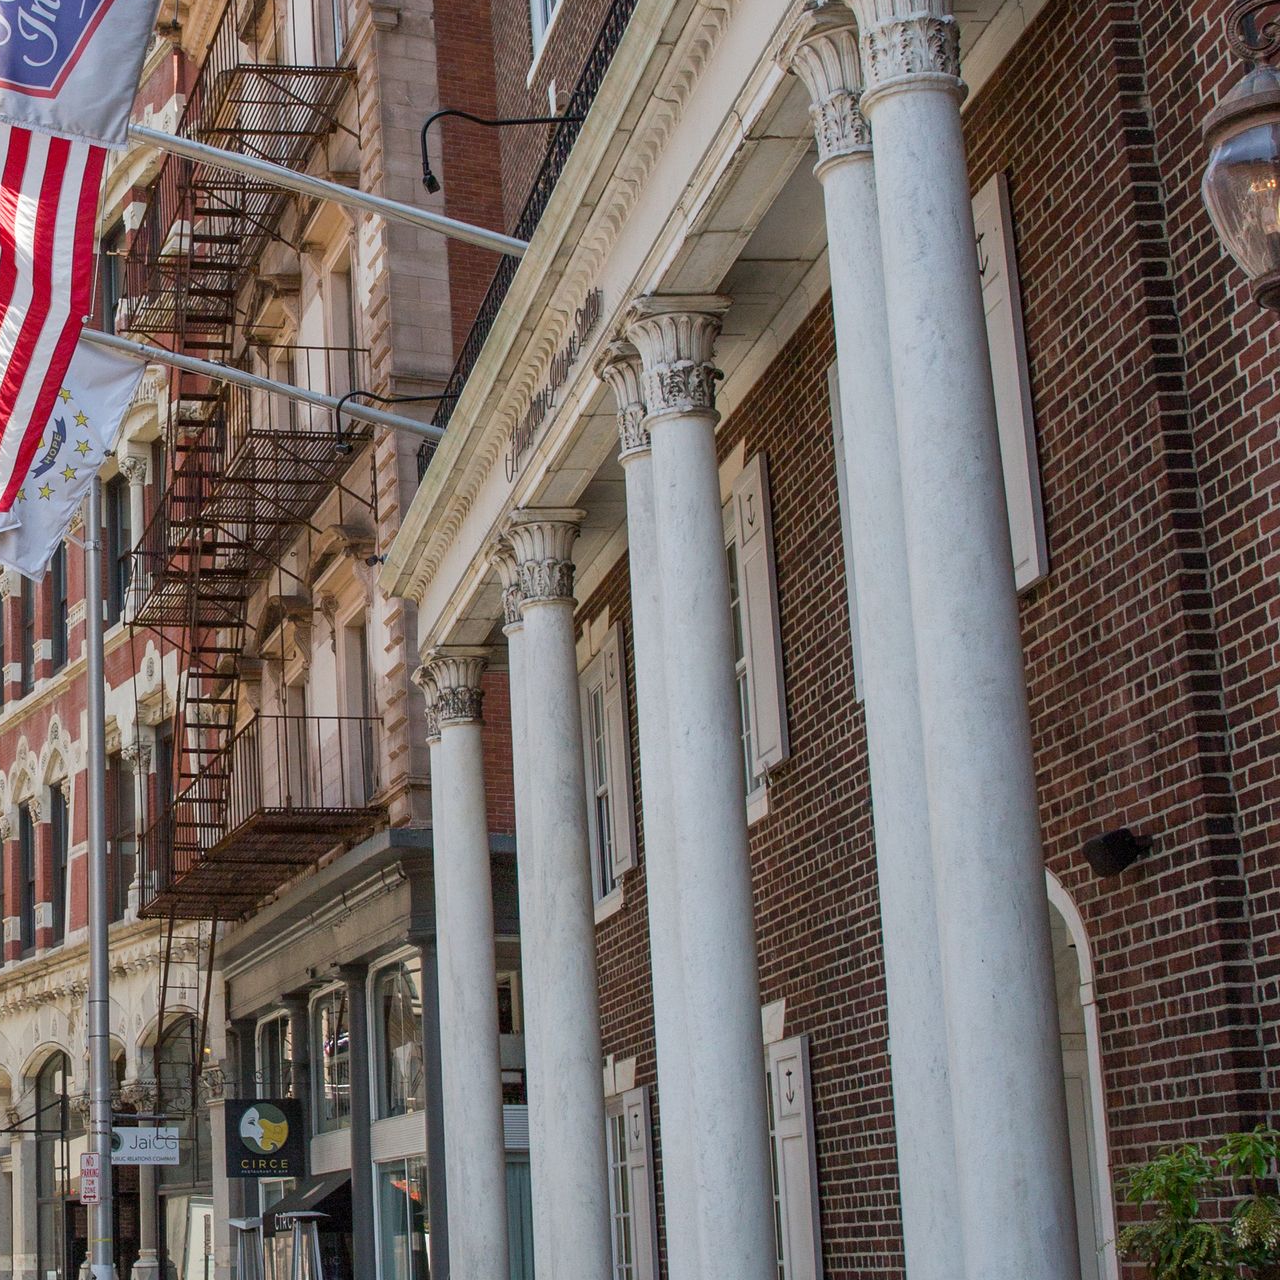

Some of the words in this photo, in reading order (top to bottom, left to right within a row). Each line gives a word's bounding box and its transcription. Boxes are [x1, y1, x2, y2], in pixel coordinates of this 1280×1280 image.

[45, 432, 62, 465] HOPE
[130, 1134, 177, 1150] JaiCG
[86, 1155, 94, 1167] NO
[241, 1159, 288, 1169] CIRCE
[80, 1168, 99, 1177] PARKING
[84, 1186, 96, 1194] ZONE
[274, 1213, 292, 1231] CIRC
